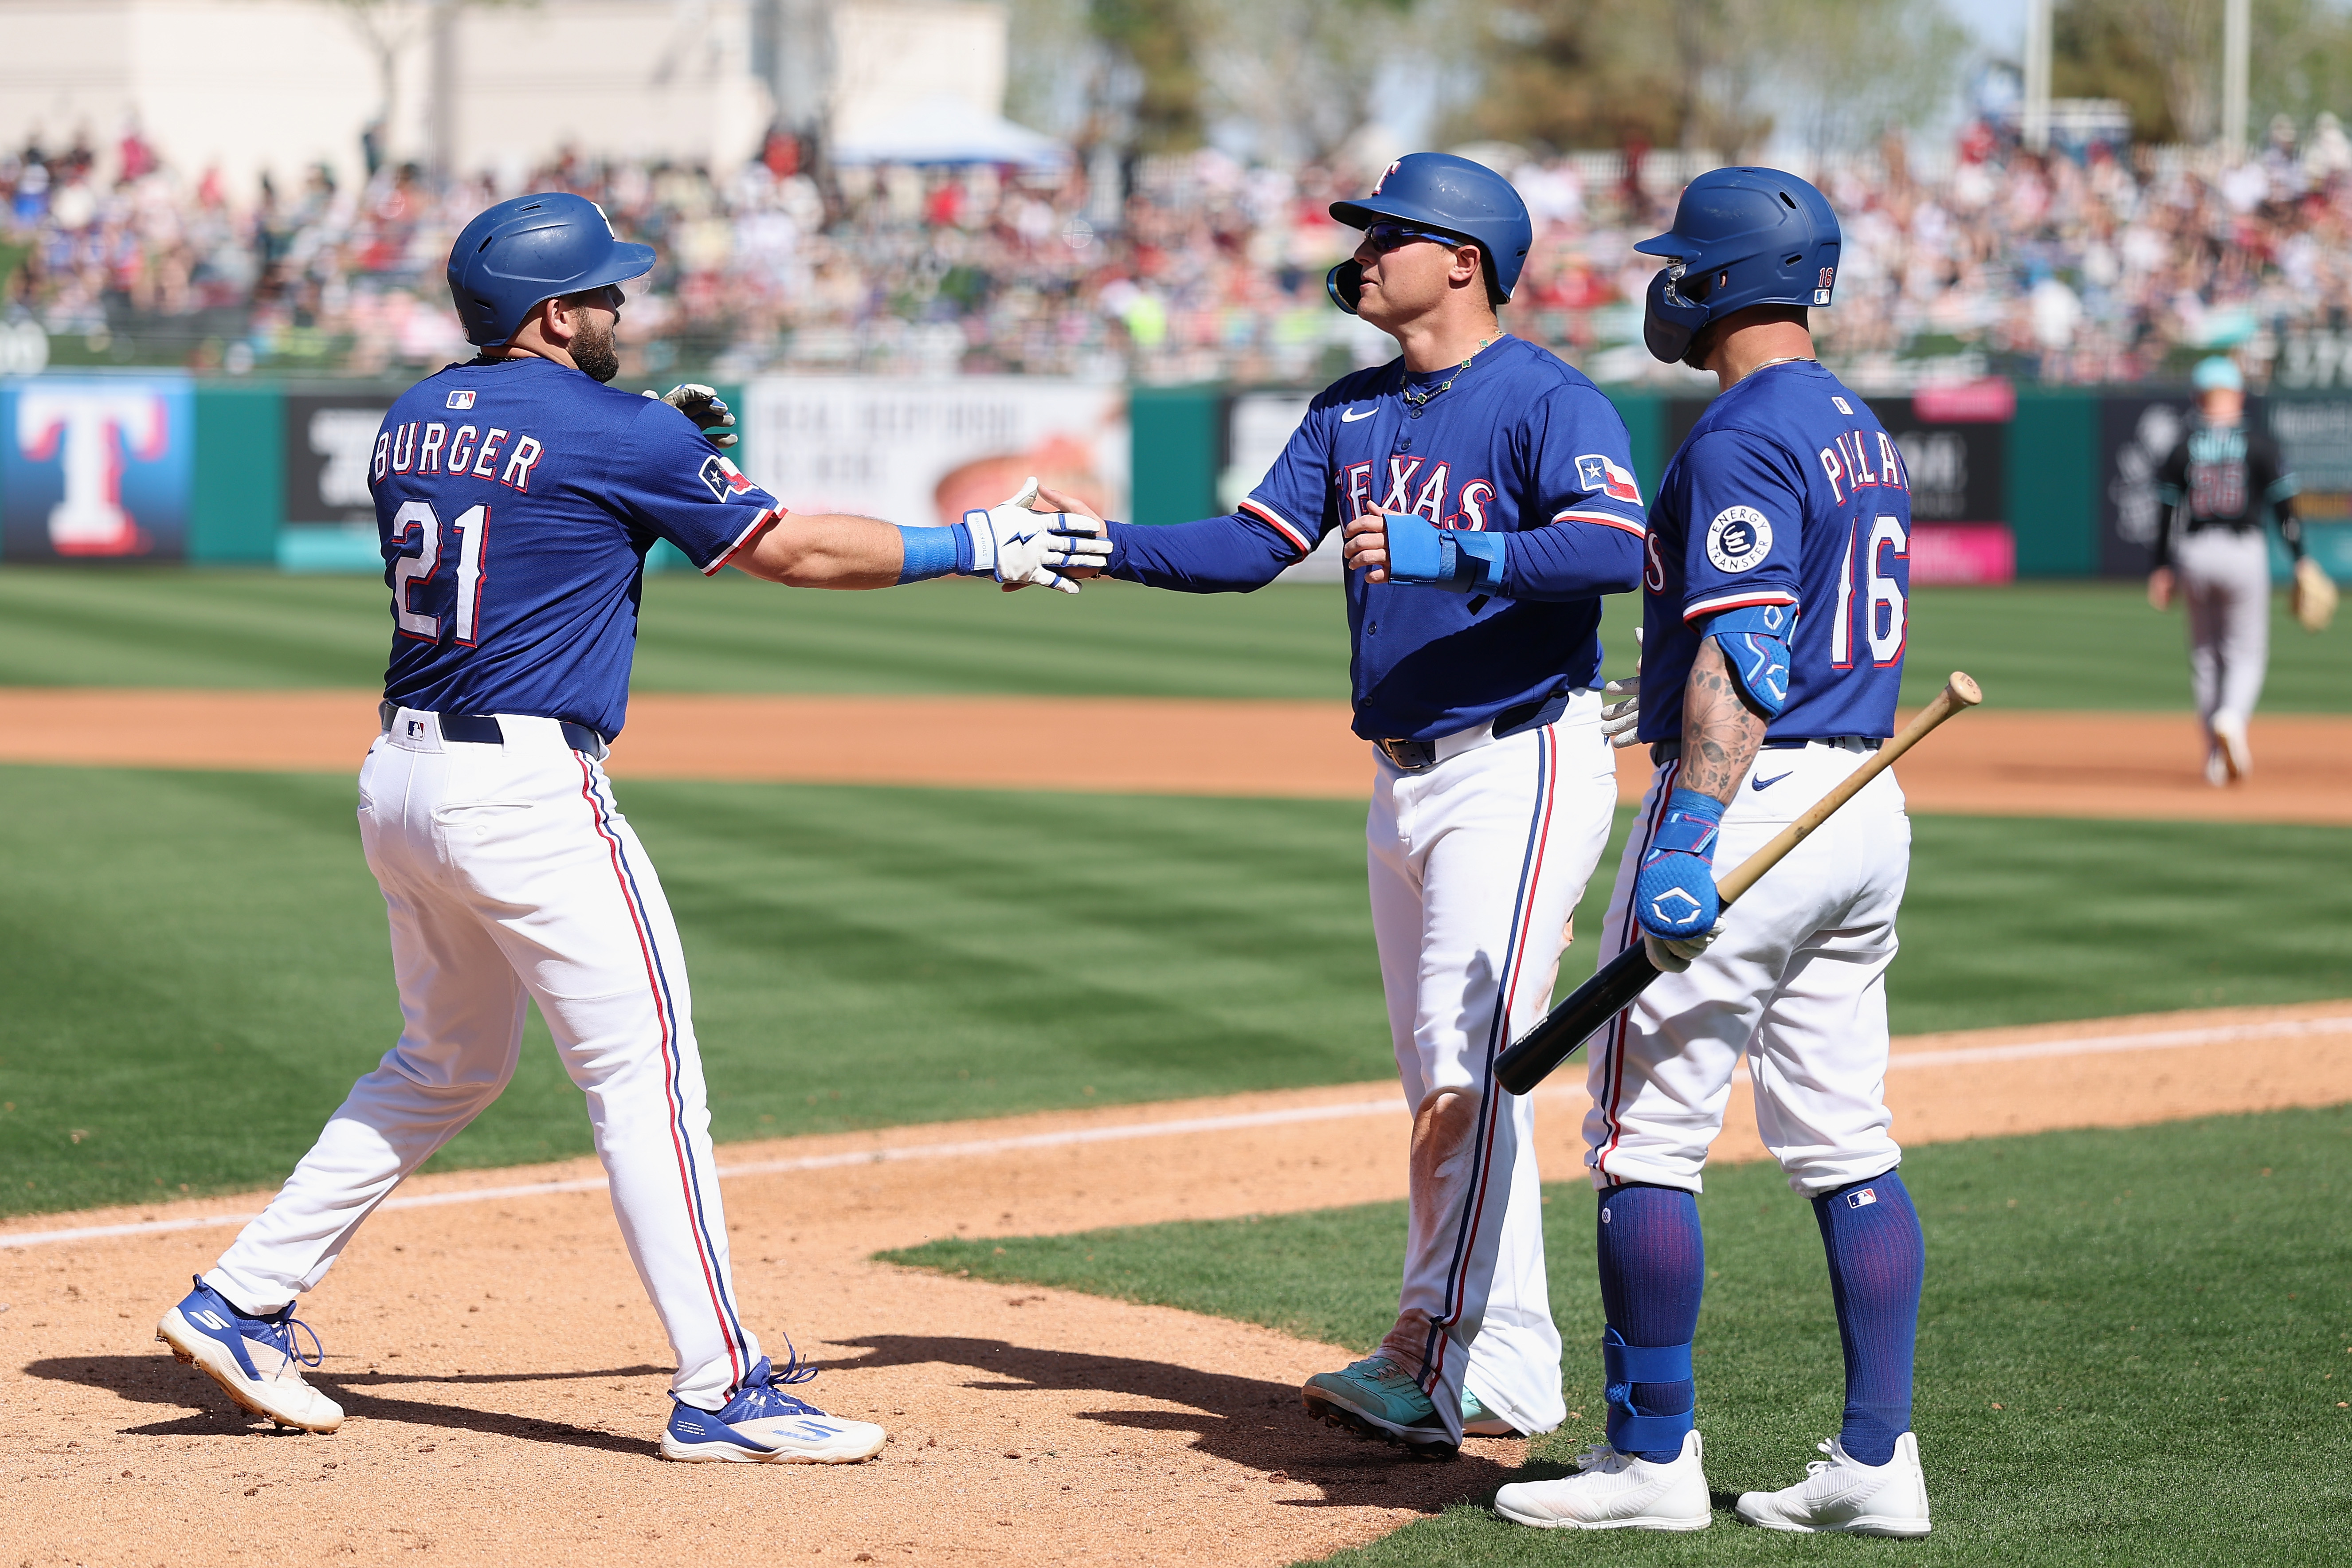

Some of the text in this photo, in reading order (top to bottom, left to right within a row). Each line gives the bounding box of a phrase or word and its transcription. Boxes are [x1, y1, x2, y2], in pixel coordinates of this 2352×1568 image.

[1818, 267, 1833, 287] 16
[17, 387, 169, 557] T
[374, 420, 545, 494] BURGER
[1819, 428, 1911, 507] PILLA
[974, 517, 984, 536] BRUCE
[1709, 540, 1769, 570] TRANSFER
[1712, 509, 1768, 533] ENERGY
[391, 498, 491, 649] 21
[1830, 513, 1910, 669] 16
